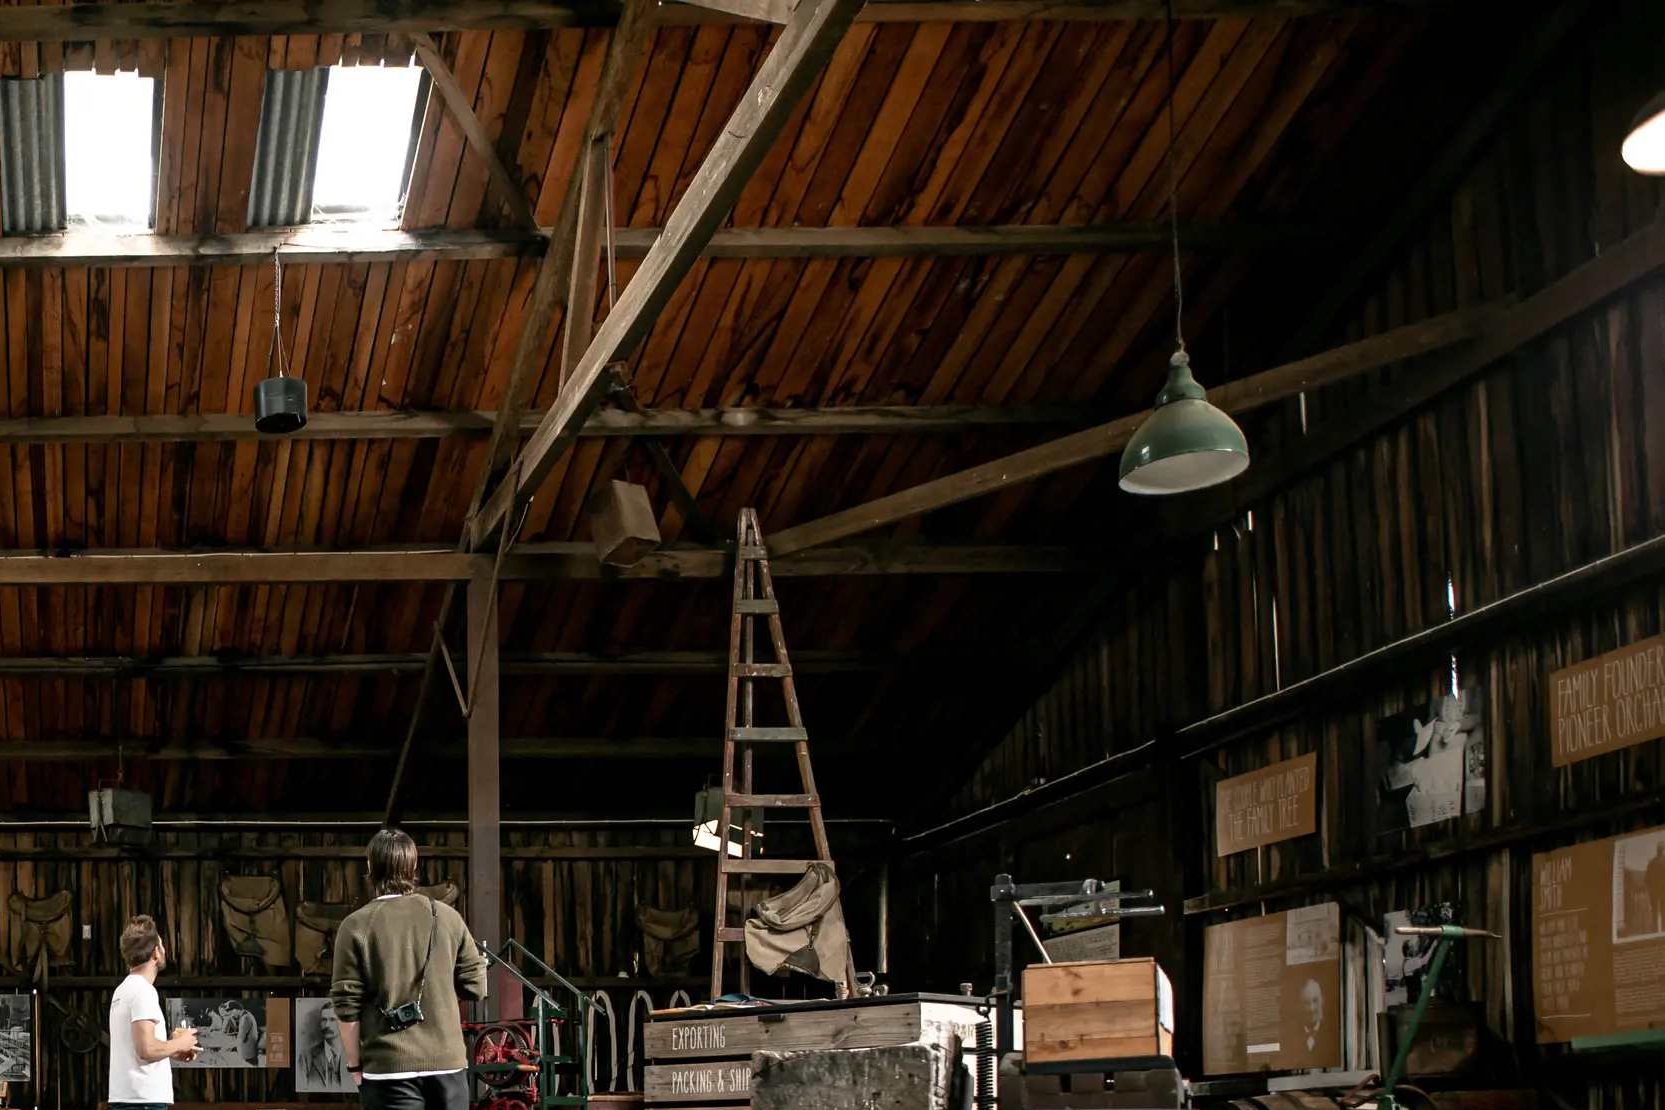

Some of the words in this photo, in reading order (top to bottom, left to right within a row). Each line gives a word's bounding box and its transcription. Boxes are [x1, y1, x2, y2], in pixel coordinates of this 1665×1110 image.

[1557, 668, 1598, 717] FAMILY
[1558, 704, 1612, 756] PIONEER
[1276, 766, 1310, 798] PLANTED
[1228, 810, 1246, 844] THE
[1247, 802, 1274, 837] FAMILY
[1278, 795, 1299, 830] TREE
[1539, 857, 1572, 886] WILLIAM
[672, 1024, 726, 1051] EXPORTING
[672, 1069, 712, 1094] PACKING
[717, 1069, 725, 1092] &
